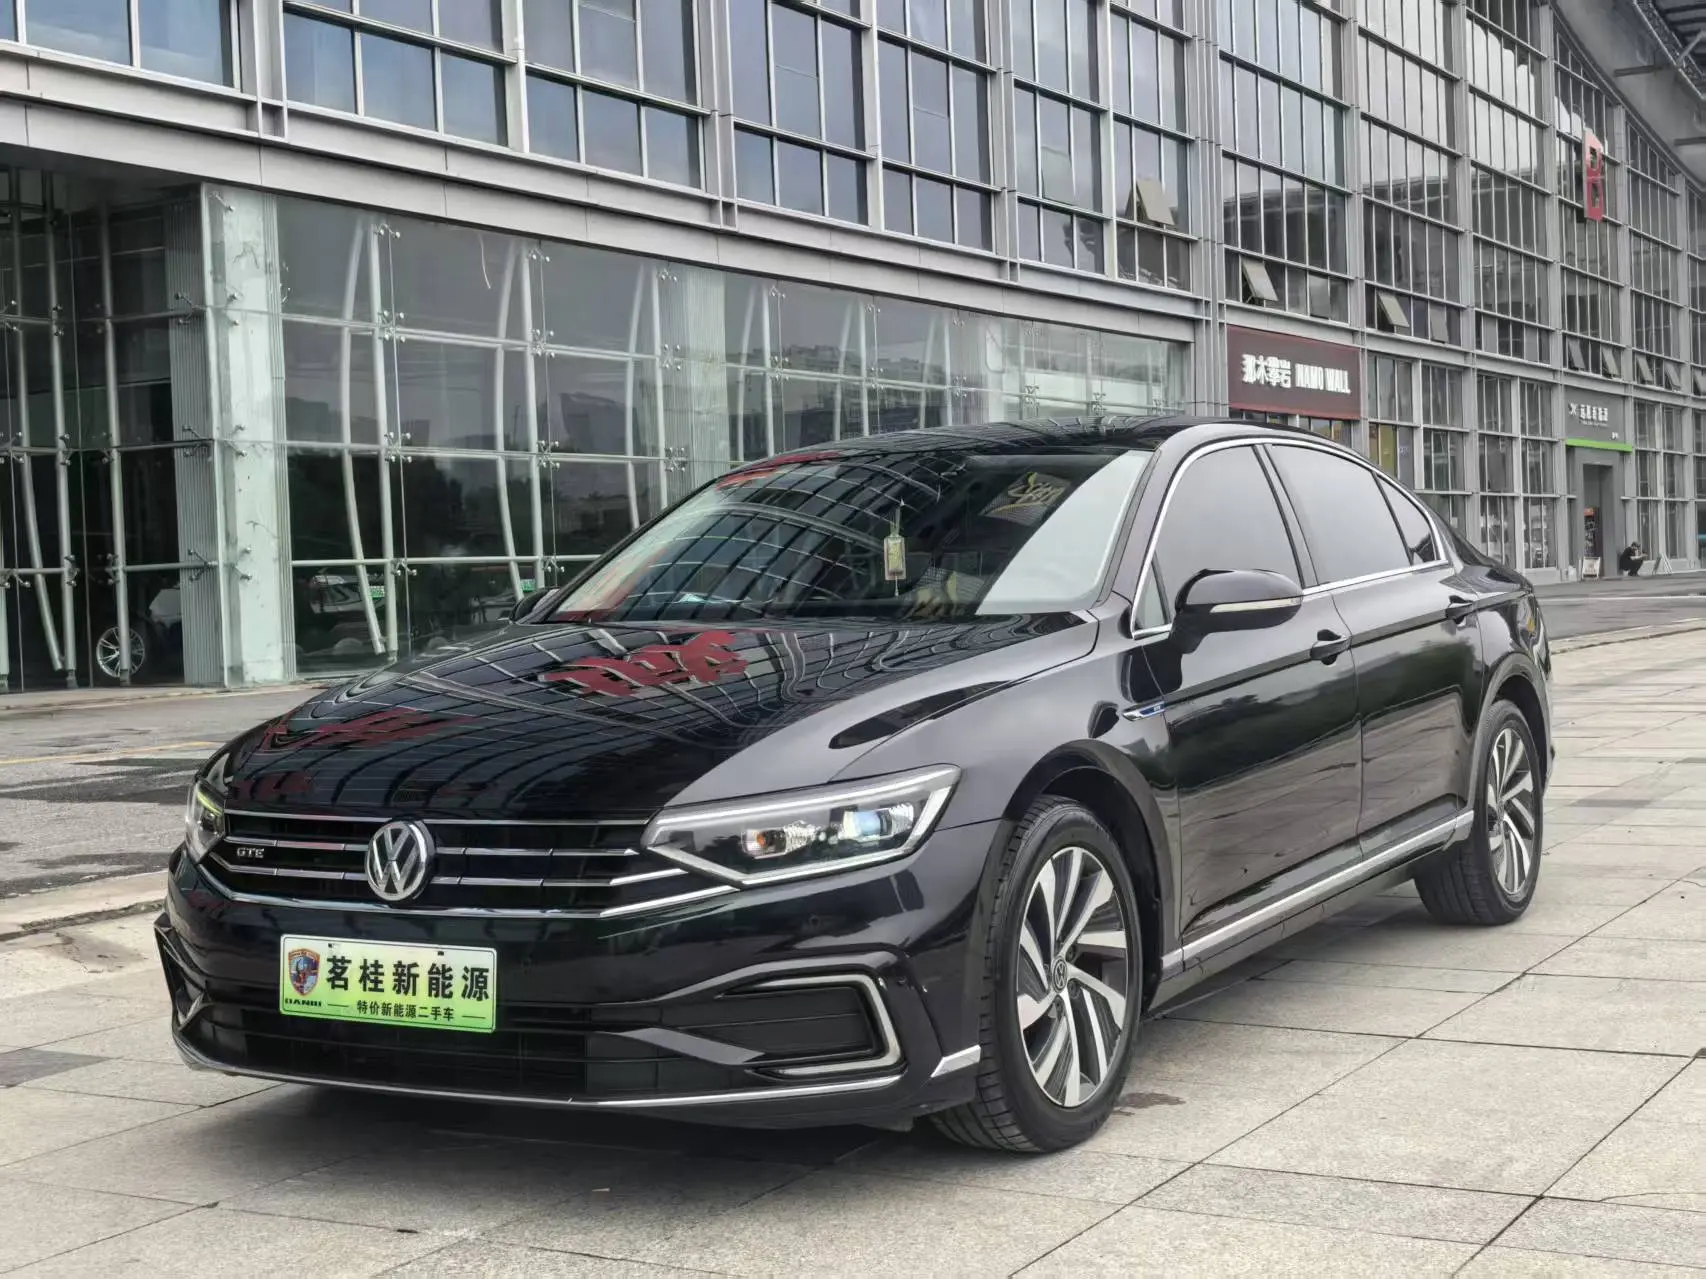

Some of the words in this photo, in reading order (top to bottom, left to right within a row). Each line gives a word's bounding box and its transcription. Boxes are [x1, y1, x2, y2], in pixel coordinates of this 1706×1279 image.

[1325, 367, 1351, 394] WALL
[237, 847, 264, 858] GTE
[326, 955, 490, 1002] 茗桂新能源
[356, 999, 455, 1022] 特价新能源二手车
